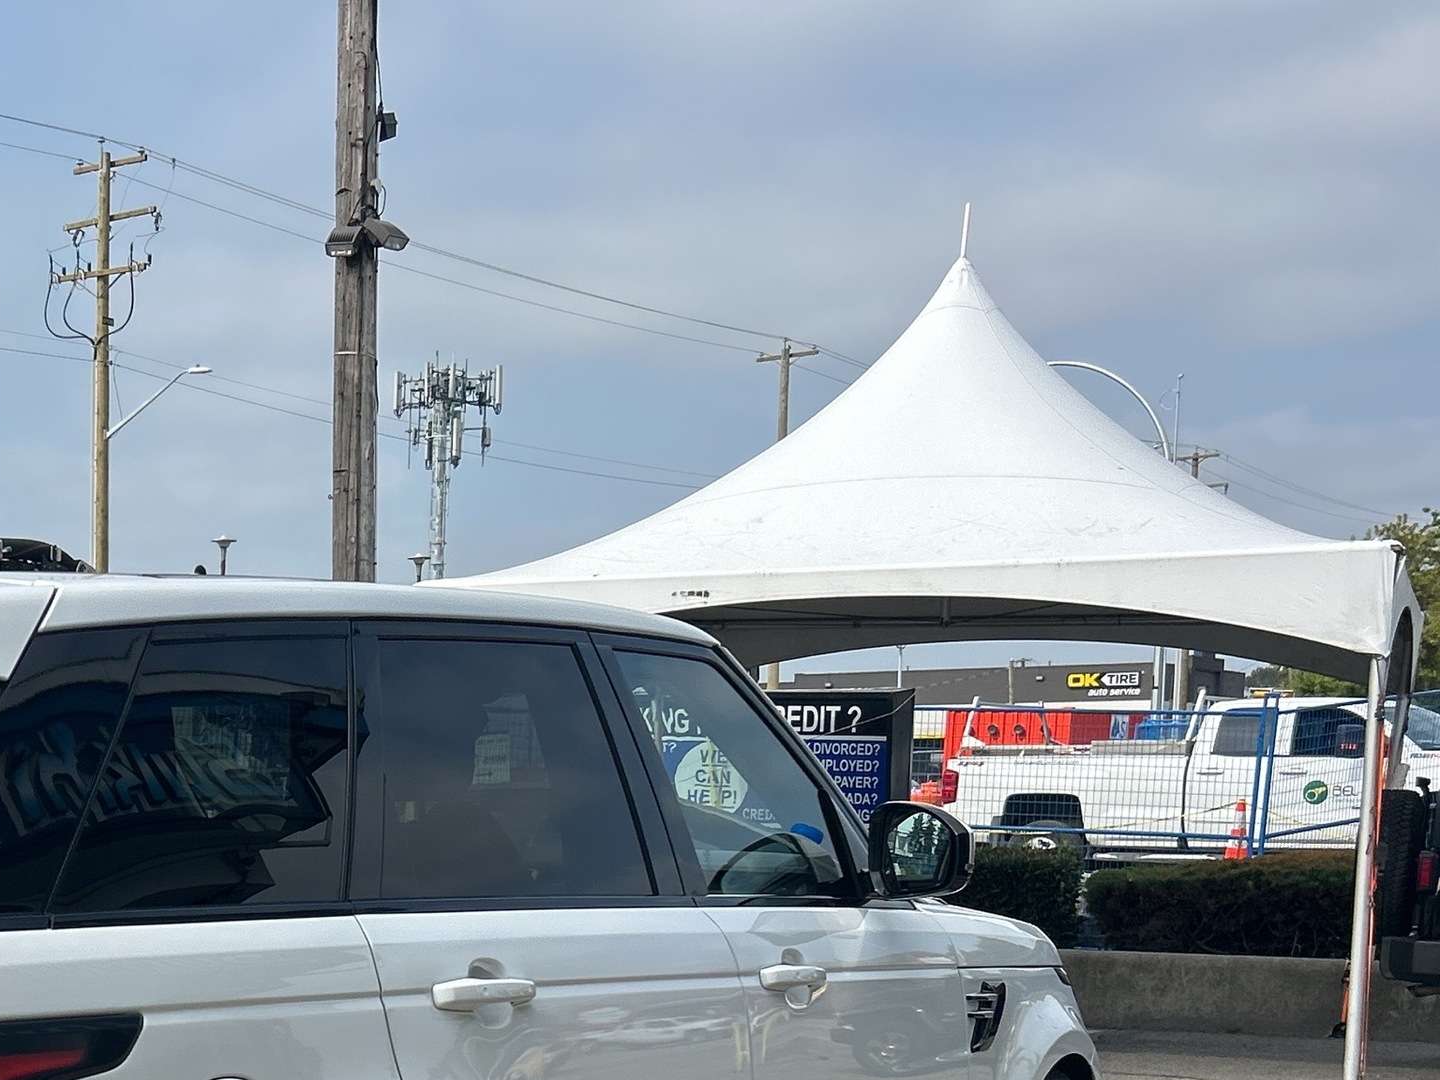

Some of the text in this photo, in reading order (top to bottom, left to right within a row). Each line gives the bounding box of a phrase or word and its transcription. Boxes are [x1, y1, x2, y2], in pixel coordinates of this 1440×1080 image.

[1067, 673, 1137, 688] OK TIRE
[1087, 687, 1141, 696] auto service
[847, 705, 862, 733] ?
[813, 743, 880, 756] DIVORCED?
[695, 769, 731, 784] CAN
[834, 776, 879, 788] PAYER?
[688, 789, 737, 805] HEP!
